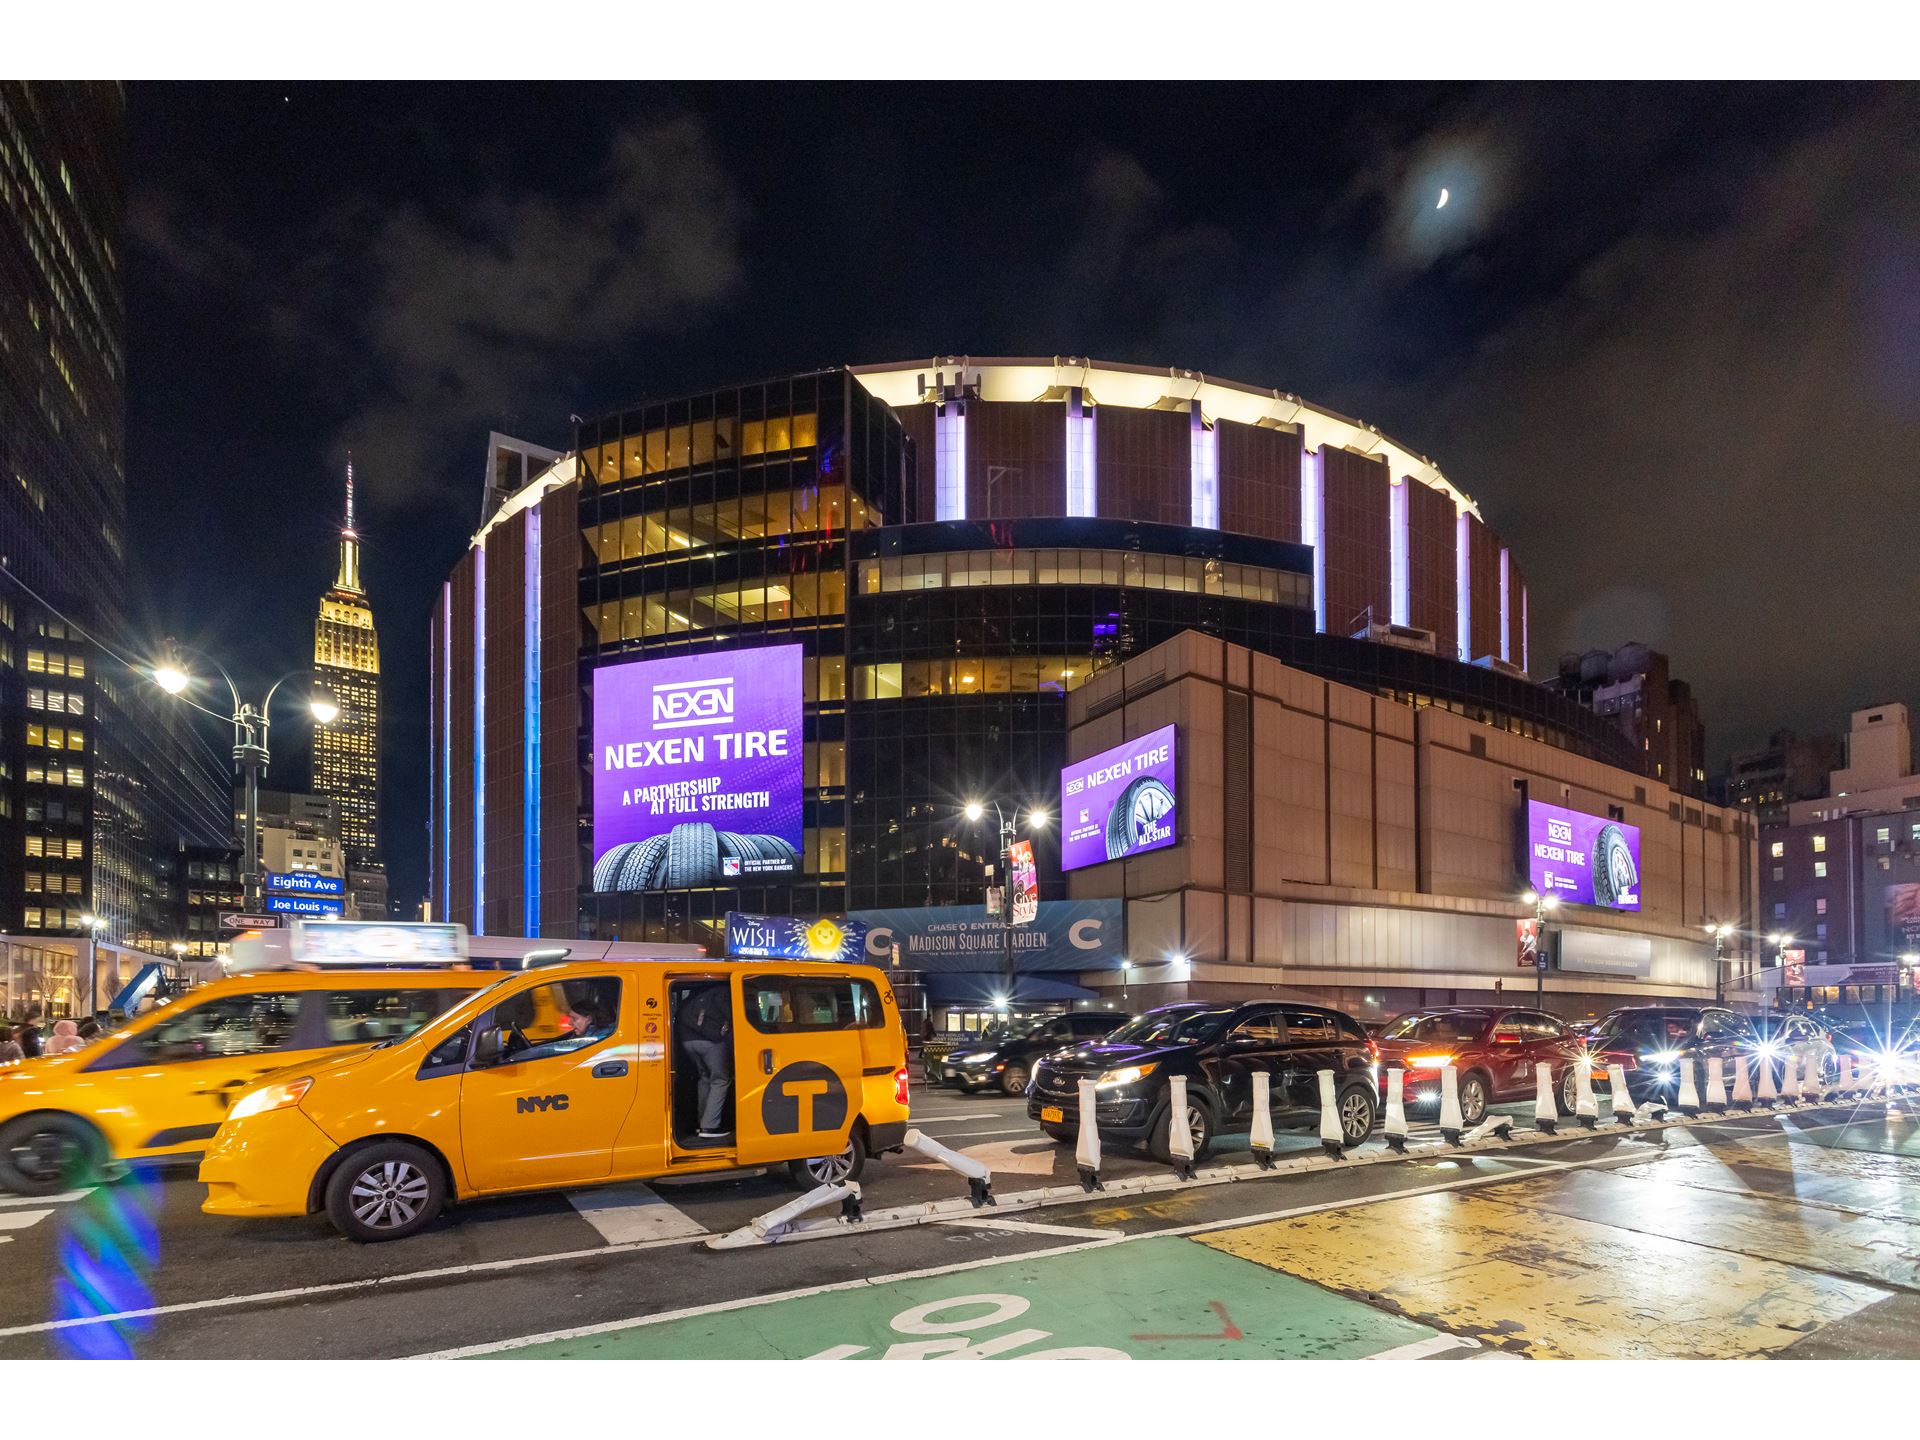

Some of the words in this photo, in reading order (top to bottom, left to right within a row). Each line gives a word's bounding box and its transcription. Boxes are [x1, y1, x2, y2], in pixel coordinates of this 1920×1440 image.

[653, 686, 734, 720] NEXEN
[605, 736, 704, 771] NEXEN
[713, 729, 788, 759] TIRE
[1088, 760, 1132, 789] NEXEN
[1135, 745, 1169, 771] TIRE
[622, 790, 631, 806] A
[634, 777, 722, 804] PARTNERSHIP
[650, 800, 665, 815] AT
[669, 797, 698, 814] FULL
[702, 792, 770, 811] STRENGTH
[1138, 826, 1171, 846] ALL-STAR
[1143, 820, 1158, 833] THE
[1548, 822, 1572, 842] NEXEN
[1534, 843, 1565, 862] NEXEN
[1566, 850, 1585, 866] TIRE
[273, 877, 312, 888] Eighth
[314, 880, 337, 890] Ave
[273, 900, 291, 909] Joe
[294, 902, 320, 911] Louis
[1014, 891, 1037, 905] Give
[1014, 903, 1037, 917] Style
[732, 927, 776, 947] WISH
[928, 924, 957, 932] CHASE
[970, 922, 1029, 930] ENTRACE
[1068, 919, 1102, 950] C
[866, 928, 893, 956] C
[909, 934, 955, 951] MADISON
[960, 933, 1000, 950] SQUARE
[516, 1094, 569, 1114] NYC
[782, 1080, 828, 1132] T
